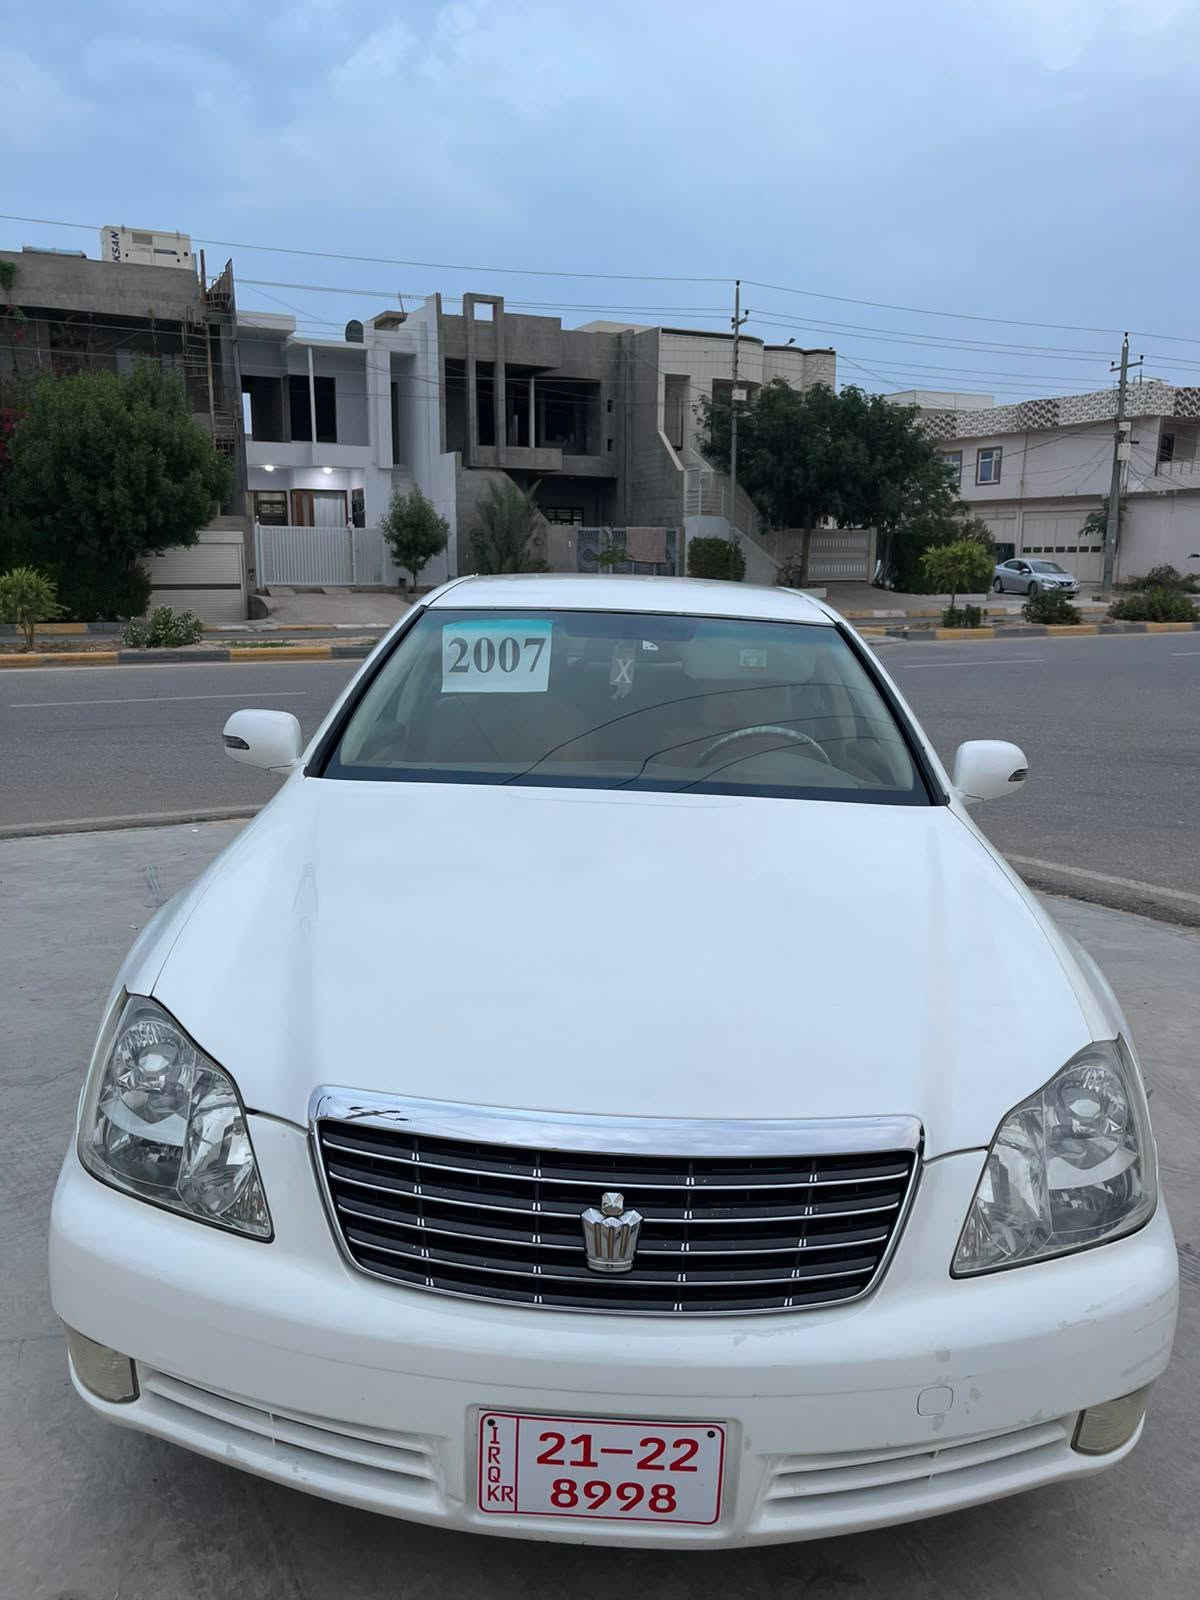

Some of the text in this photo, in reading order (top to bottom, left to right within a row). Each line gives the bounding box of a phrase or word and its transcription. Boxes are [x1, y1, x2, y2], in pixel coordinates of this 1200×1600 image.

[111, 231, 121, 264] KSAN
[448, 637, 546, 673] 2007
[487, 1485, 514, 1502] KR
[550, 1479, 677, 1513] 8998
